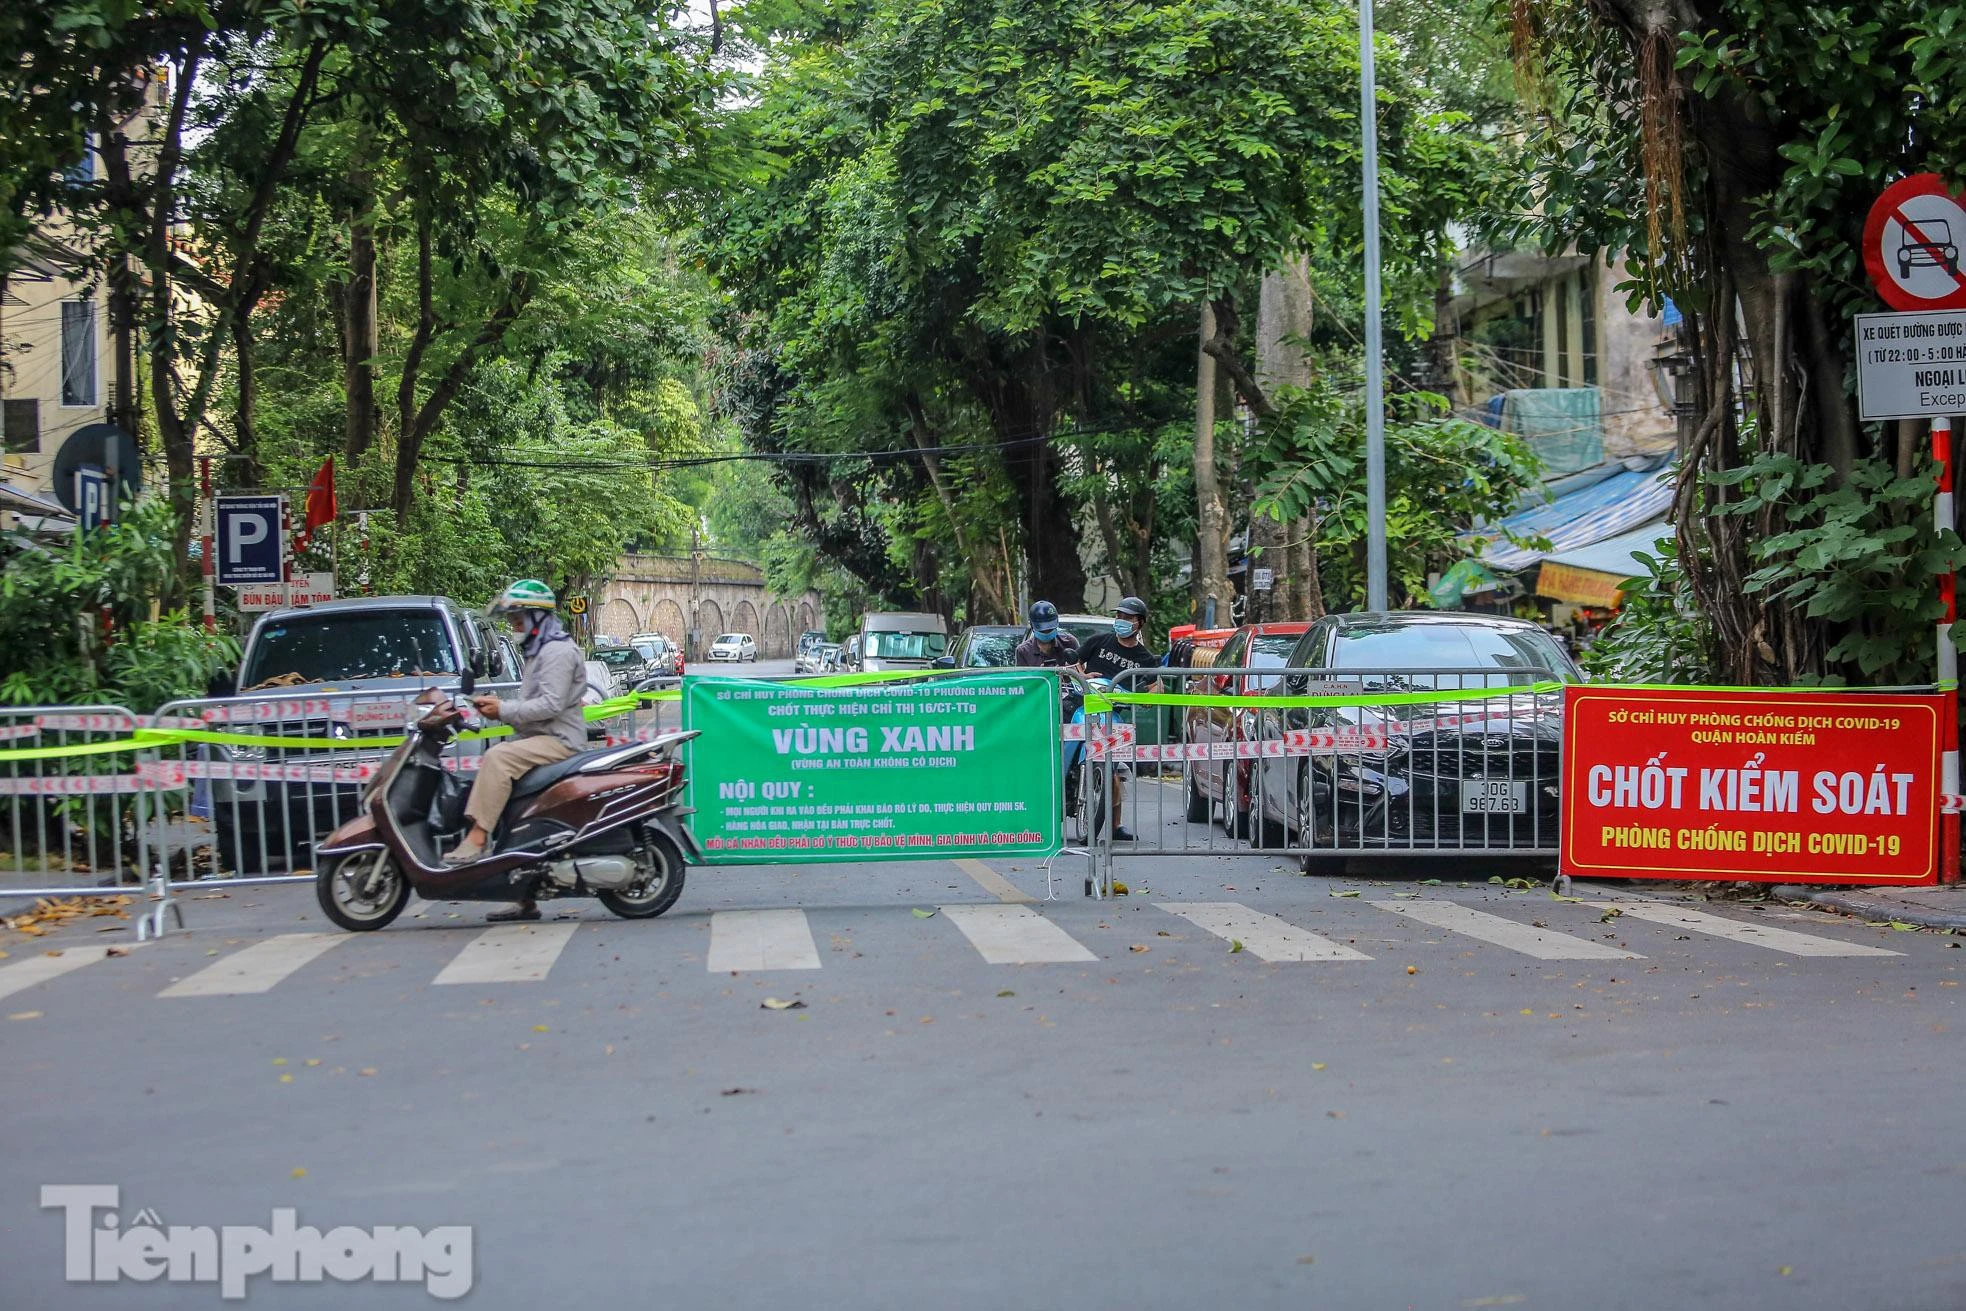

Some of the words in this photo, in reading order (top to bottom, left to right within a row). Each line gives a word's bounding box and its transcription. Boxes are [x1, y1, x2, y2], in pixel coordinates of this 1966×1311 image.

[1864, 327, 1875, 340] XE
[1878, 324, 1901, 339] QUÉT
[1903, 322, 1934, 338] ĐƯỜNG
[1938, 321, 1962, 338] ĐƯỢC
[1916, 370, 1954, 388] NGOẠI
[229, 514, 268, 563] P
[291, 590, 309, 605] ẮM
[717, 690, 731, 700] SỞ
[734, 689, 751, 700] CHỈ
[755, 690, 775, 699] HUY
[978, 686, 1006, 696] HÀNG
[768, 702, 800, 716] CHỐT
[804, 704, 835, 717] THỰC
[839, 703, 868, 717] HIỆN
[872, 700, 892, 714] CHỈ
[896, 703, 914, 715] THỊ
[920, 702, 976, 714] 16/CT-TTg
[1608, 708, 1629, 724] SỞ
[1631, 710, 1654, 725] CHỈ
[1657, 713, 1686, 726] HUY
[1690, 711, 1741, 727] PHÒNG
[1744, 710, 1796, 728] CHỐNG
[1798, 715, 1833, 732] DỊCH
[1835, 717, 1901, 730] COVID-19
[772, 723, 868, 754] VÙNG
[880, 726, 975, 753] XANH
[1691, 728, 1733, 746] QUẬN
[1736, 729, 1777, 744] HOÀN
[1780, 729, 1816, 745] KIẾM
[827, 759, 841, 769] AN
[844, 757, 870, 768] TOÀN
[874, 756, 909, 767] KHÔNG
[912, 756, 925, 766] CÓ
[719, 779, 755, 803] NỘI
[762, 782, 802, 801] QUY
[1588, 752, 1688, 809] CHỐT
[1699, 753, 1799, 813] KIỂM
[1812, 763, 1914, 816] SOÁT
[856, 805, 874, 814] KHAI
[976, 803, 992, 813] QUY
[936, 834, 952, 846] GIA
[991, 831, 1015, 847] CỘNG
[1602, 822, 1671, 849] PHÒNG
[1677, 823, 1747, 852] CHỐNG
[1753, 830, 1801, 857] DỊCH
[1808, 833, 1901, 856] COVID-19
